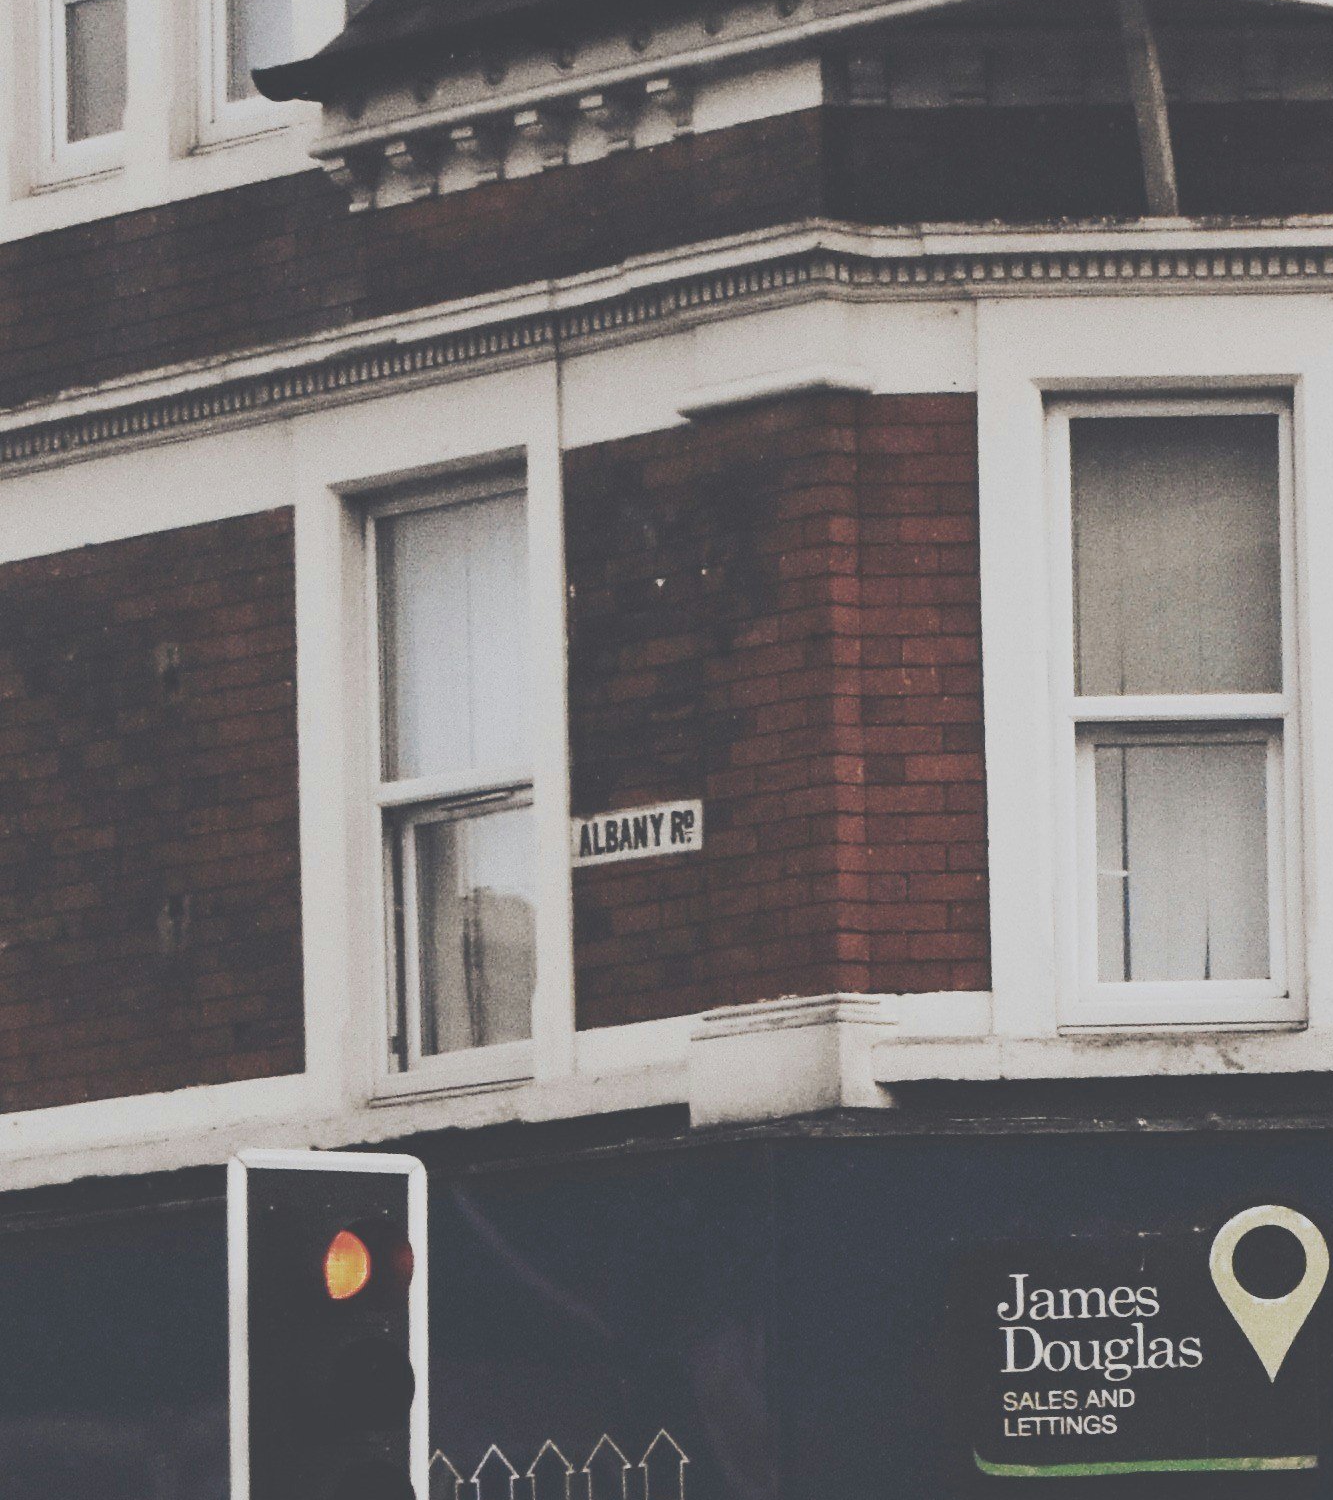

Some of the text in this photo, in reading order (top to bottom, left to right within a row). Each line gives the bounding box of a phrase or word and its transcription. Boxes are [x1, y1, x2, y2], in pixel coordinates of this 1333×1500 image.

[579, 813, 664, 857] ALBANY
[997, 1273, 1159, 1321] James
[999, 1323, 1203, 1381] Douglas
[1003, 1388, 1135, 1411] SALES AND
[1003, 1414, 1118, 1437] LETTINGS
